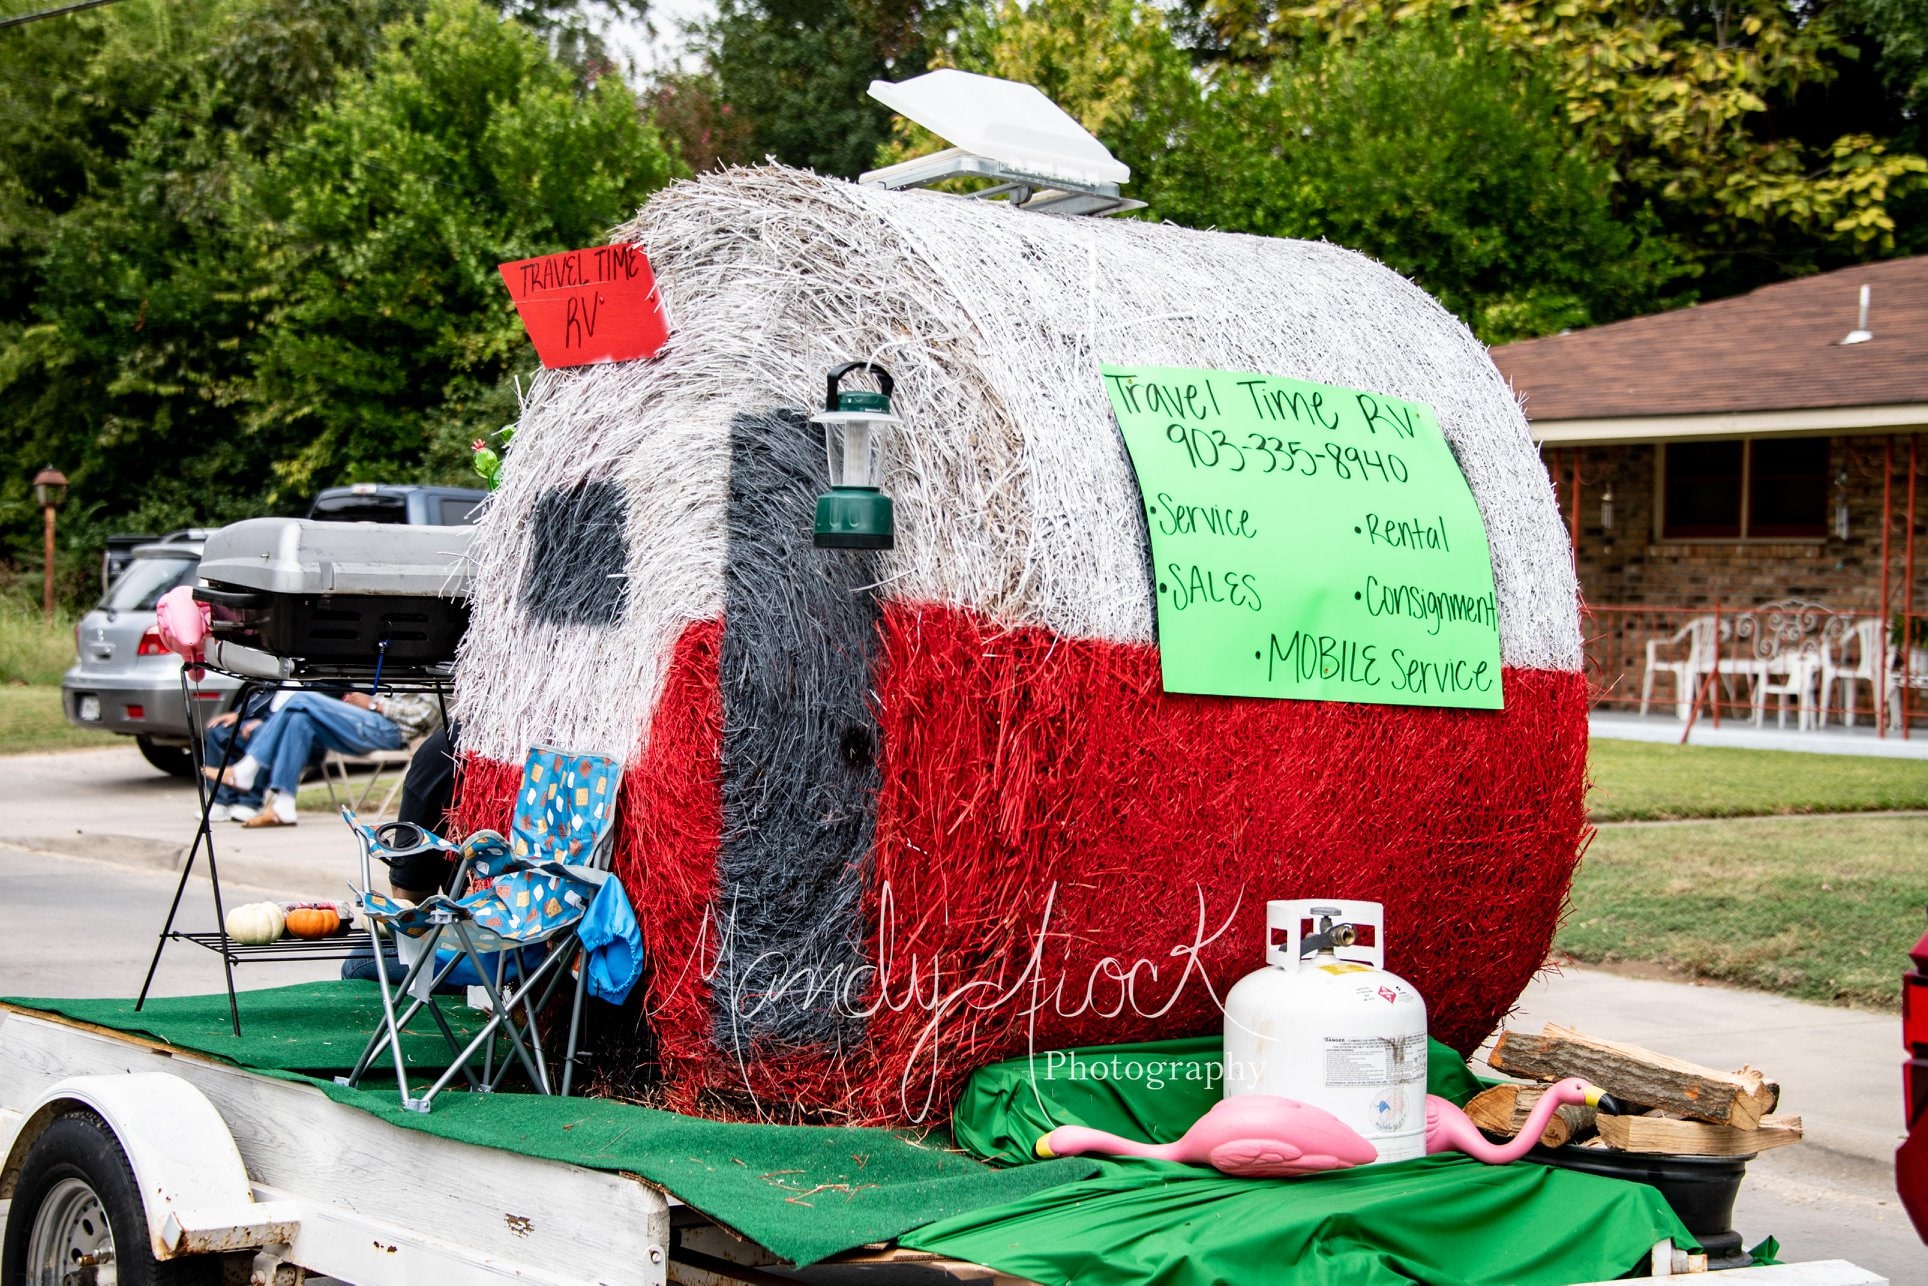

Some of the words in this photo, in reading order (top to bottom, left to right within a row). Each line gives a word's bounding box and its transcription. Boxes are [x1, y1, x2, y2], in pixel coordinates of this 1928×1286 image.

[520, 253, 589, 297] TRAVEL
[594, 247, 638, 282] TIME
[566, 291, 599, 349] RV
[1105, 373, 1221, 420] Travel
[1237, 379, 1339, 430] Time
[1356, 393, 1415, 439] RV
[1166, 423, 1408, 483] 903-335-8940
[1157, 492, 1257, 539] Service
[1366, 513, 1450, 553] Rental
[1168, 563, 1262, 612] SALES
[1366, 575, 1498, 635] Consignment
[1268, 630, 1382, 685] MOBILE
[1391, 648, 1492, 694] Service
